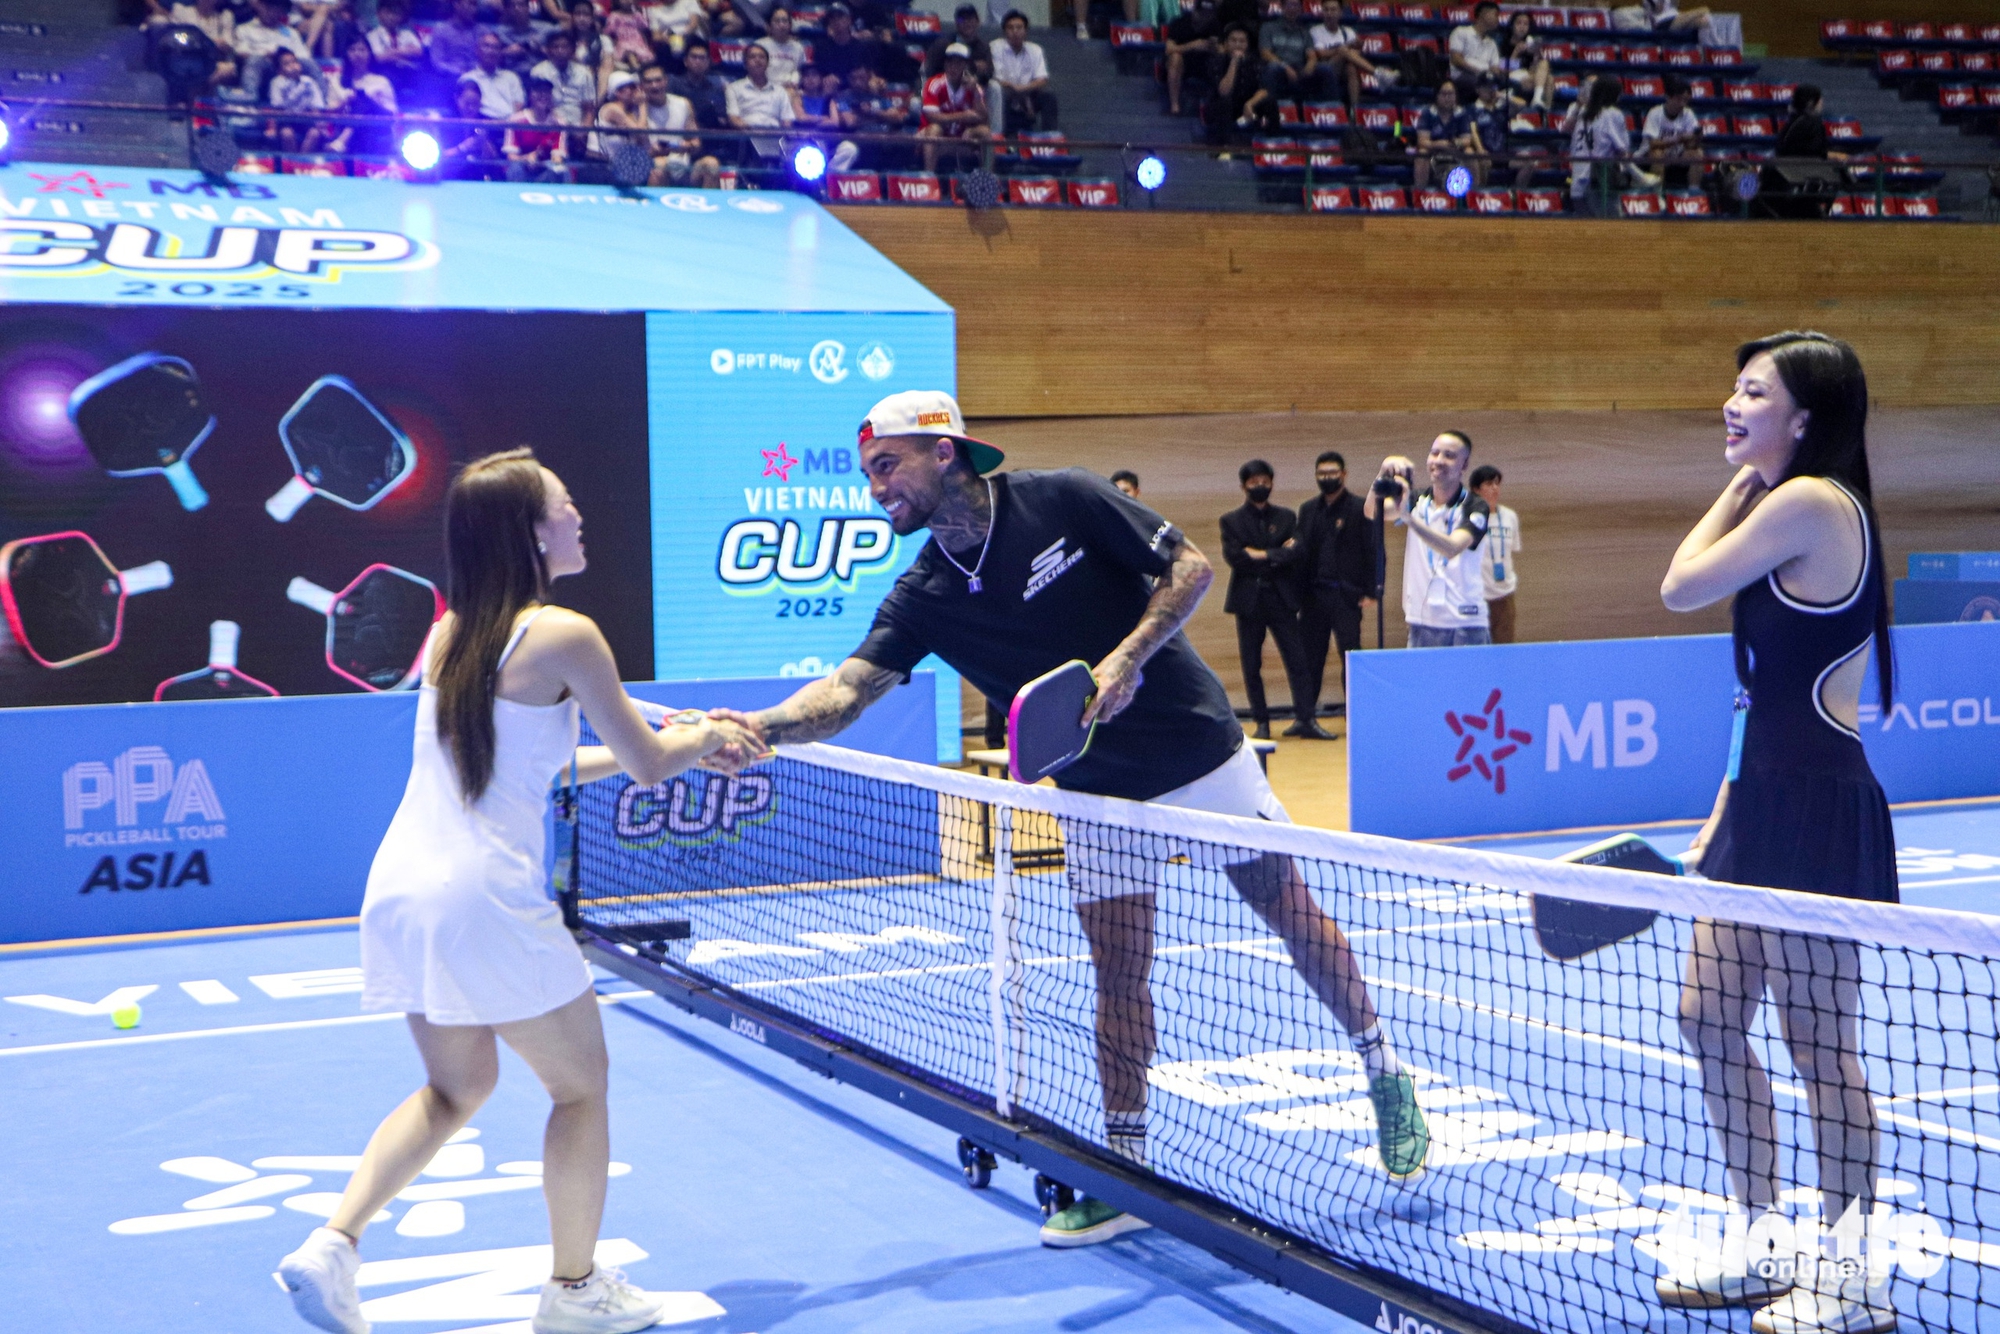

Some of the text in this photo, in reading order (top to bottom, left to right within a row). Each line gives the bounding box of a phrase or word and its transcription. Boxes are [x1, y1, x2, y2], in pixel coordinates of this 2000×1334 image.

[1358, 7, 1381, 20] VIP
[1402, 8, 1425, 20] VIP
[904, 19, 933, 32] VIP
[1118, 32, 1142, 44] VIP
[1631, 83, 1654, 97] VIP
[1311, 112, 1336, 126] VIP
[1363, 113, 1388, 128] VIP
[148, 178, 278, 199] MB
[837, 181, 869, 197] VIP
[898, 183, 929, 199] VIP
[1019, 186, 1048, 202] VIP
[1077, 189, 1106, 205] VIP
[1312, 195, 1340, 209] VIP
[1368, 196, 1395, 210] VIP
[1420, 196, 1447, 210] VIP
[1476, 197, 1501, 212] VIP
[1525, 197, 1549, 212] VIP
[0, 198, 345, 228] VIETNAM
[1624, 200, 1650, 214] VIP
[1673, 201, 1698, 216] VIP
[1904, 203, 1928, 216] VIP
[0, 217, 411, 276] CUP
[117, 281, 312, 299] 2025
[737, 353, 766, 369] FPT
[769, 353, 801, 373] Play
[804, 447, 852, 475] MB
[744, 485, 873, 514] VIETNAM
[718, 517, 893, 584] CUP
[1023, 546, 1086, 602] SKECHERS
[776, 597, 844, 618] 2025
[1545, 698, 1659, 773] MB
[62, 745, 227, 831] PPA
[616, 773, 773, 839] CUP
[65, 823, 228, 848] PICKLEBALL TOUR
[78, 848, 213, 895] ASIA
